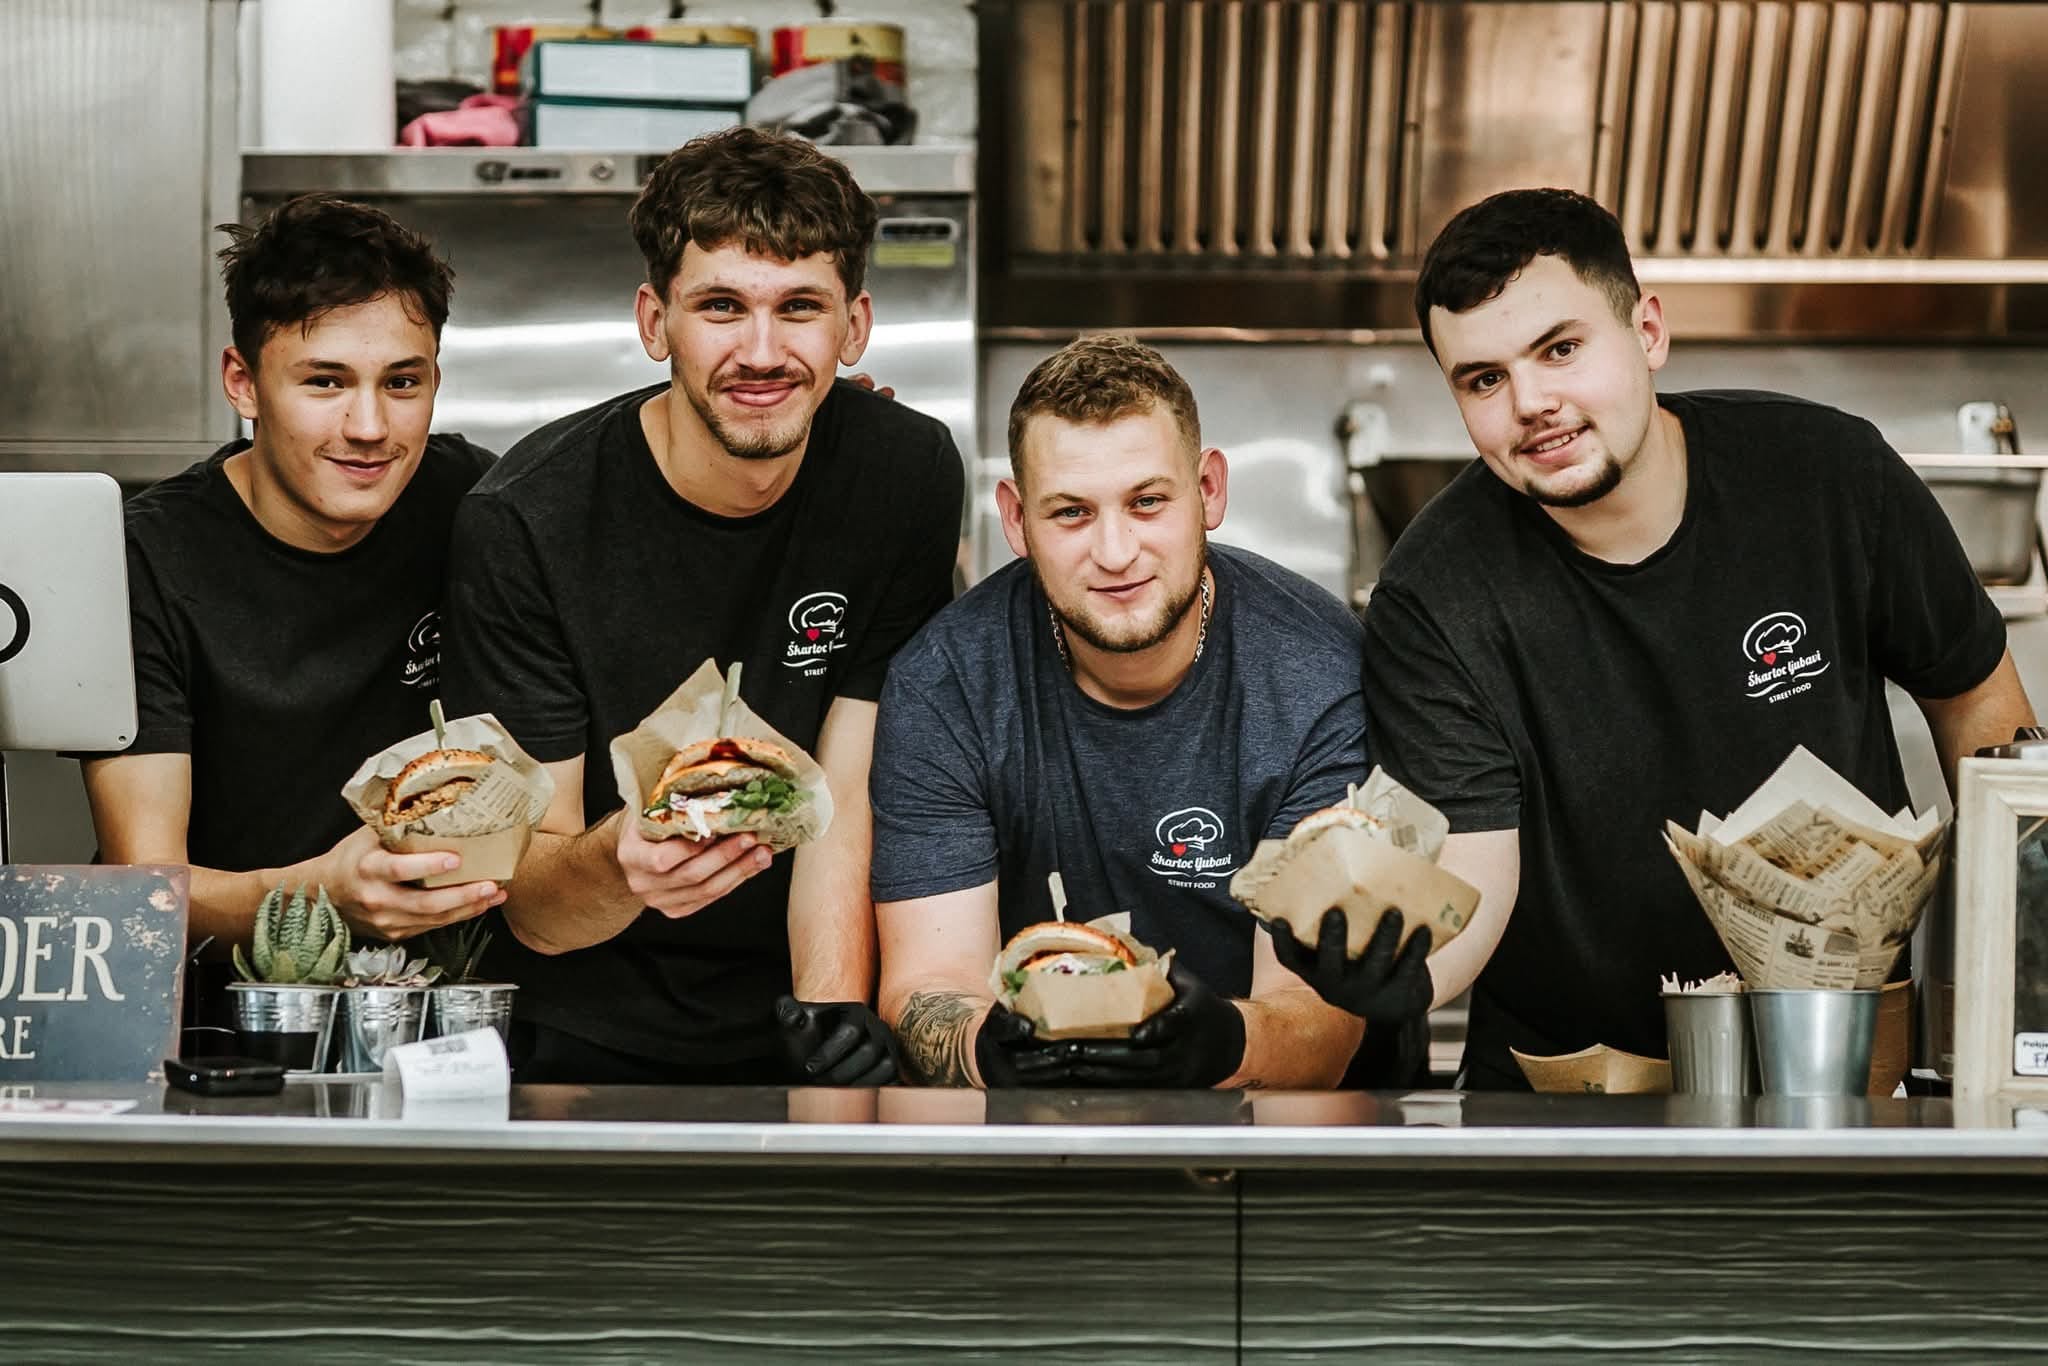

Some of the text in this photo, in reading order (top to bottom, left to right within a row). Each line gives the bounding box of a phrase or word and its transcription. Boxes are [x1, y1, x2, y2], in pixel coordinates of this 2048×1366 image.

[1747, 650, 1822, 687] Škartoc ljubavi
[1769, 682, 1812, 703] STREET FOOD
[1151, 850, 1193, 868] Škartoc
[1168, 879, 1192, 889] STREET
